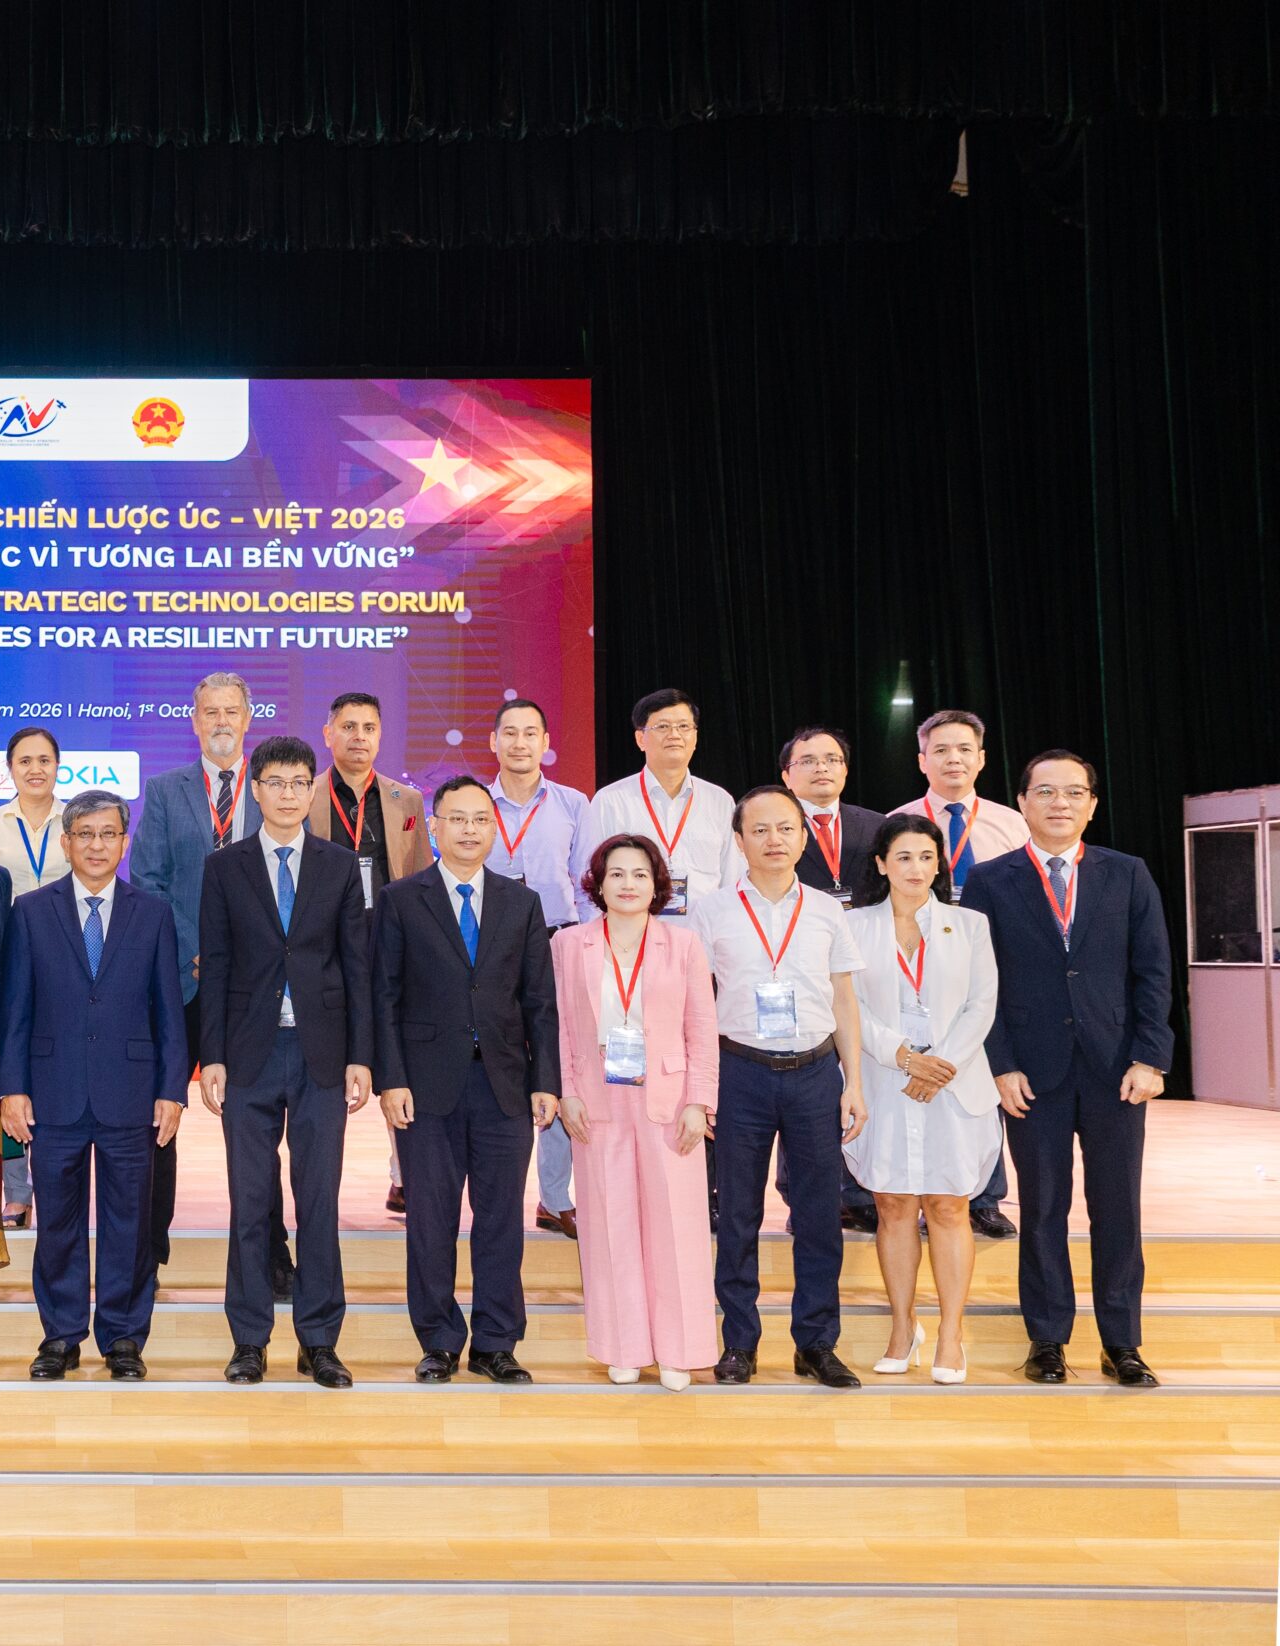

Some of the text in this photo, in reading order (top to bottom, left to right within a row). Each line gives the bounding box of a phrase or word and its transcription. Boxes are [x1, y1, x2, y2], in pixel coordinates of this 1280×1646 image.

[88, 504, 170, 535] LƯỢC
[179, 501, 221, 529] ÚC
[252, 501, 323, 535] VIỆT
[330, 507, 406, 530] 2026
[29, 541, 58, 567] VÌ
[68, 543, 175, 568] TƯƠNG
[185, 546, 232, 568] LAI
[243, 537, 303, 568] BỀN
[132, 591, 355, 614] TECHNOLOGIES
[360, 591, 465, 613] FORUM
[38, 626, 97, 648] FOR
[101, 626, 122, 648] A
[128, 626, 275, 649] RESILIENT
[19, 703, 63, 718] 2026
[78, 702, 132, 720] Hanoi,
[56, 765, 121, 785] OKIA
